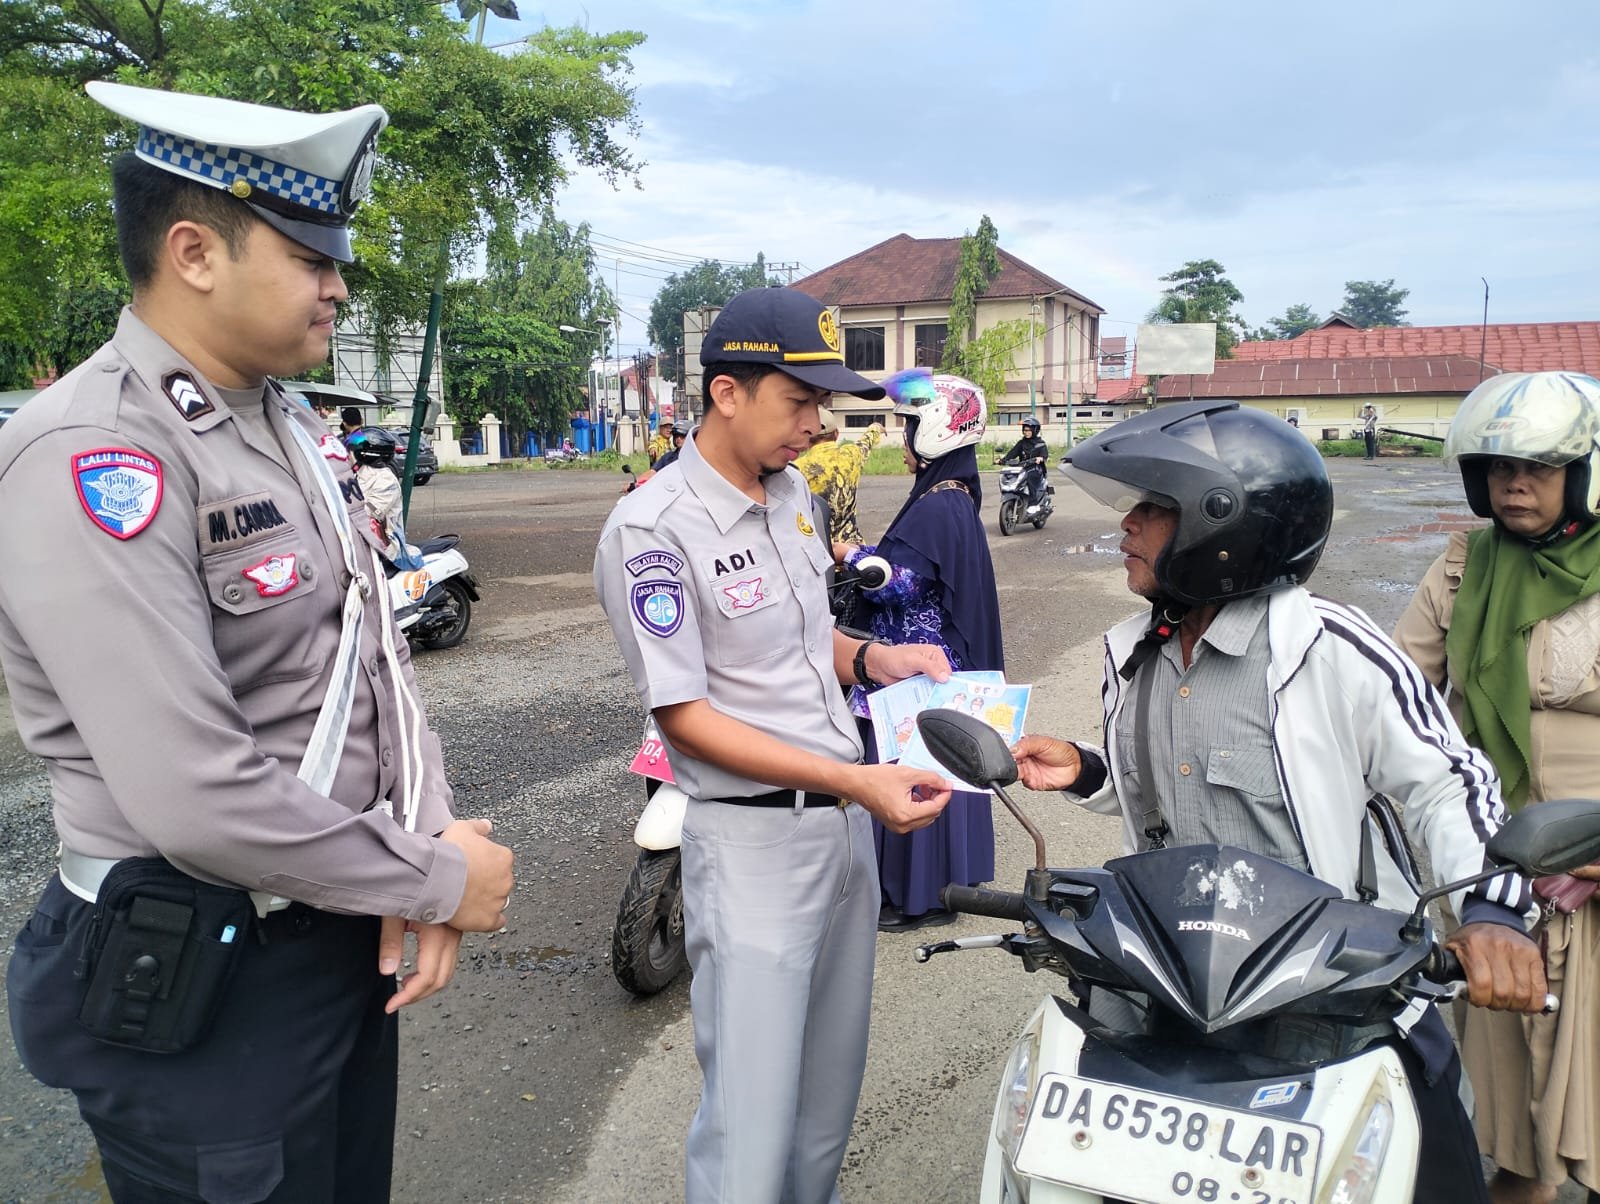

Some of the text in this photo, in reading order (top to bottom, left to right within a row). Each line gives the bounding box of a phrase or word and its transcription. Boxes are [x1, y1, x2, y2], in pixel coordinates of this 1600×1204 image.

[723, 342, 779, 353] JASA RAHARJA
[80, 452, 156, 471] LALU LINTAS
[715, 549, 755, 576] ADI
[637, 586, 653, 597] JASA
[643, 742, 664, 759] DA
[1178, 921, 1251, 941] HONDA
[1258, 1085, 1296, 1101] FI
[1042, 1081, 1309, 1177] DA 6538 LAR
